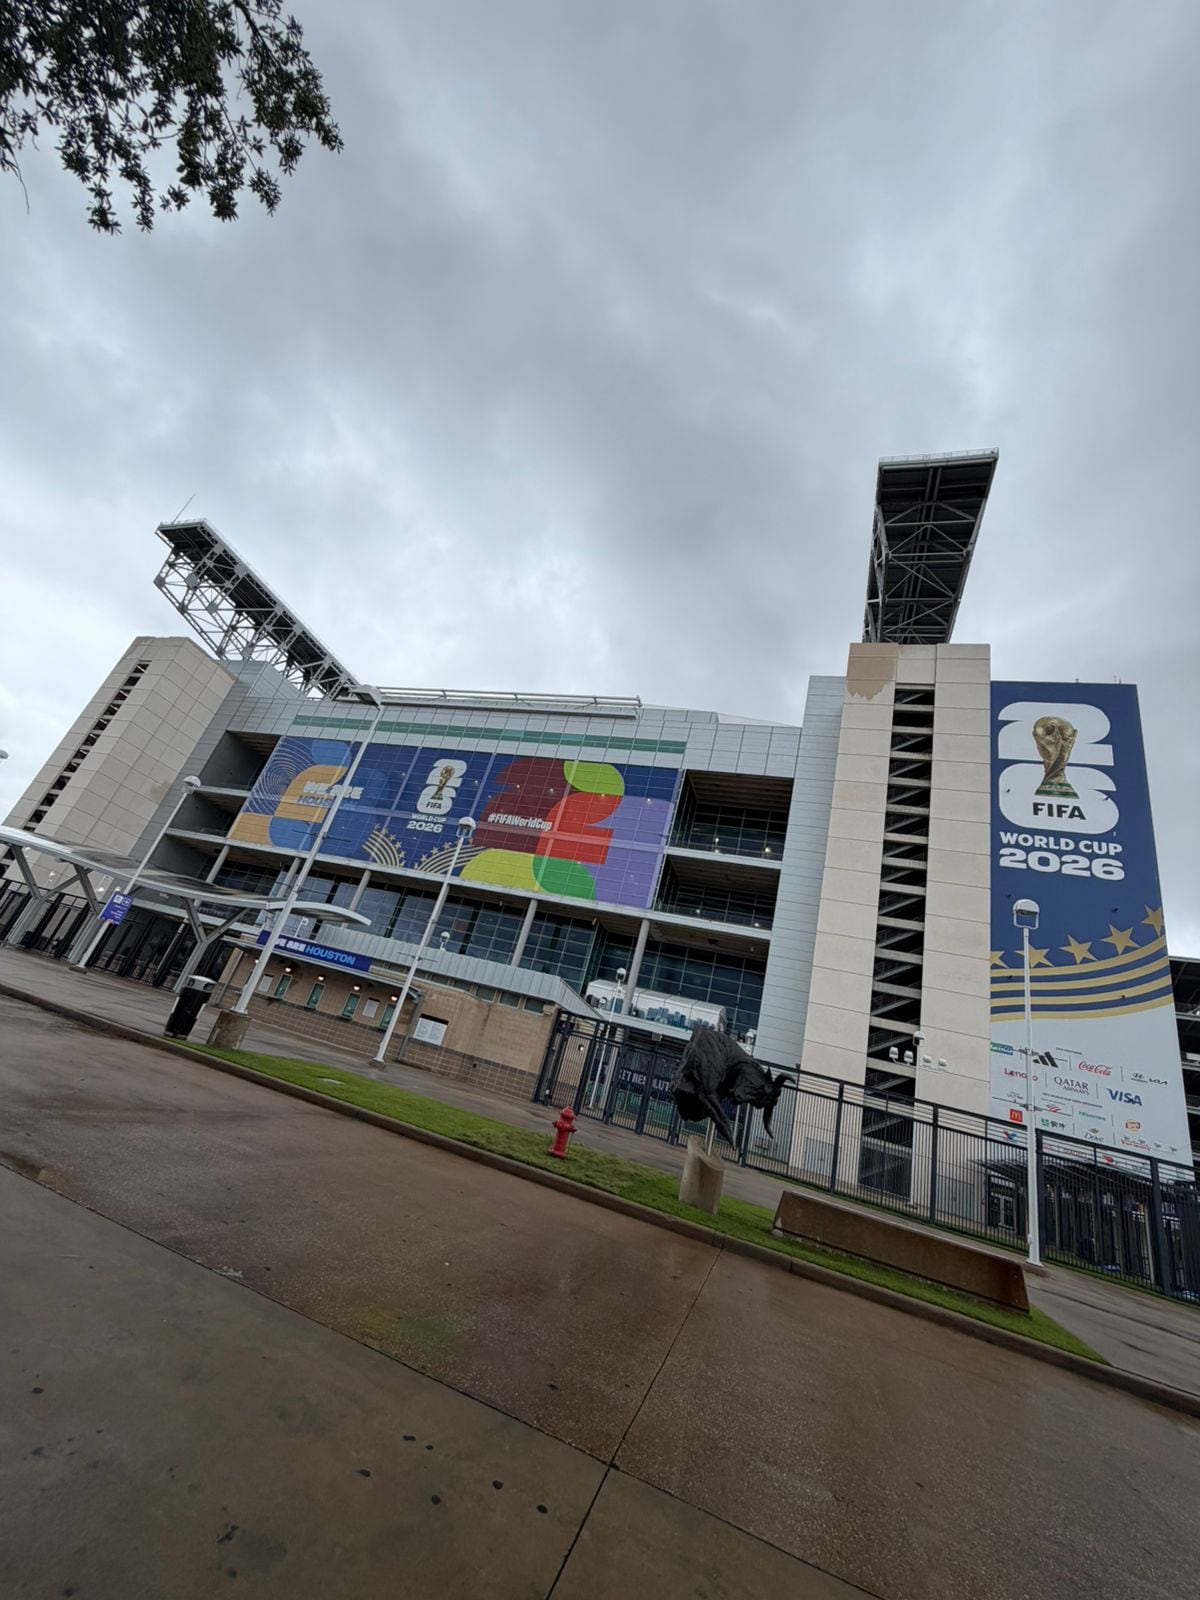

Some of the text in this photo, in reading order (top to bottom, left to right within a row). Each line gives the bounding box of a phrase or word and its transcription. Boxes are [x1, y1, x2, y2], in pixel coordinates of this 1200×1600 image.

[303, 780, 331, 795] WE
[425, 801, 442, 809] FIFA
[1032, 802, 1087, 820] FIFA
[411, 813, 434, 822] WORLD
[487, 812, 553, 832] #FIFAWorldCup
[406, 820, 444, 833] 2026
[999, 831, 1123, 856] WORLD CUP
[999, 847, 1126, 881] 2026
[286, 940, 306, 952] ARE
[305, 945, 356, 965] HOUSTON
[1004, 1067, 1039, 1081] Lenoo
[1053, 1075, 1089, 1090] QATAR
[1106, 1088, 1143, 1106] VISA
